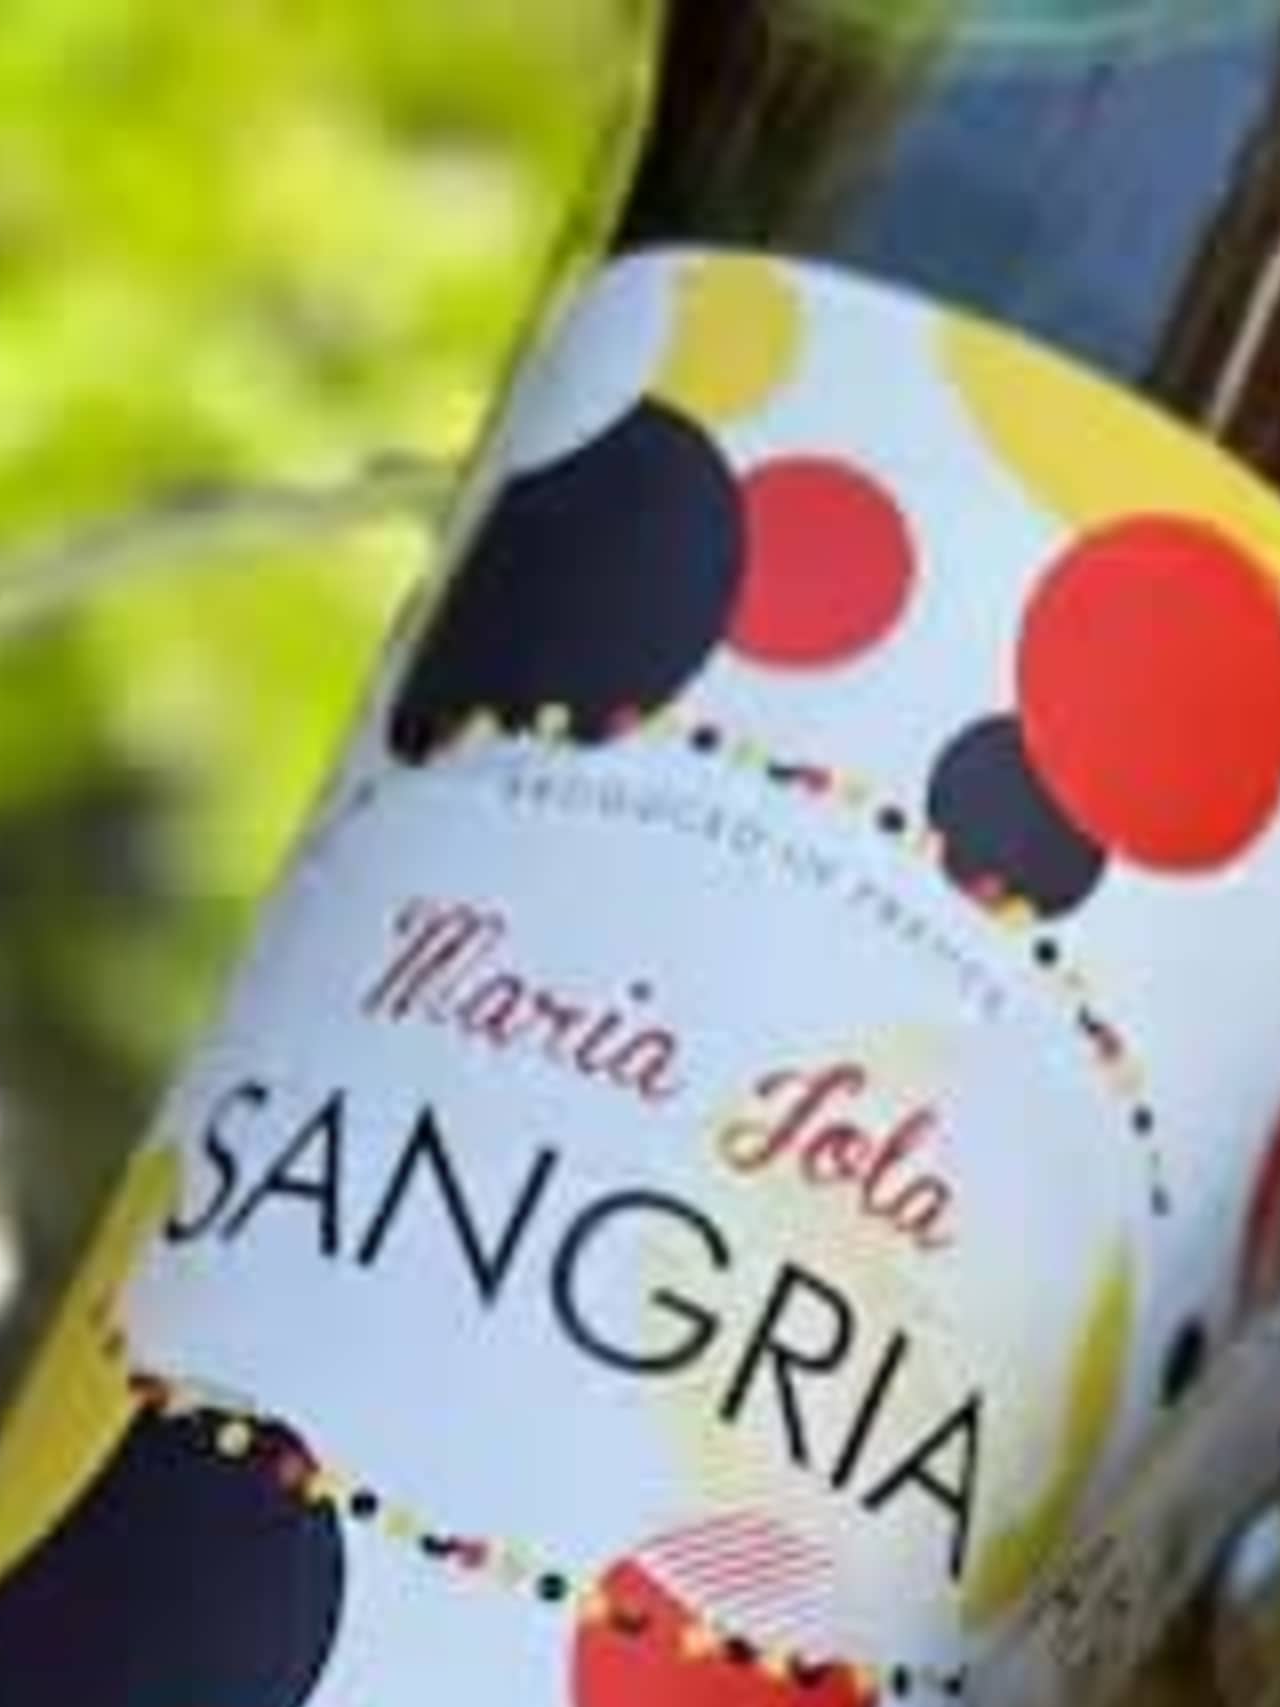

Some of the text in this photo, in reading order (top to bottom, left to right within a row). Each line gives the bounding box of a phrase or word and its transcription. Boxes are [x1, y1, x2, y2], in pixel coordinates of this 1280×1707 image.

[362, 896, 958, 1252] Maria Jola
[164, 1080, 988, 1580] SANGRIA
